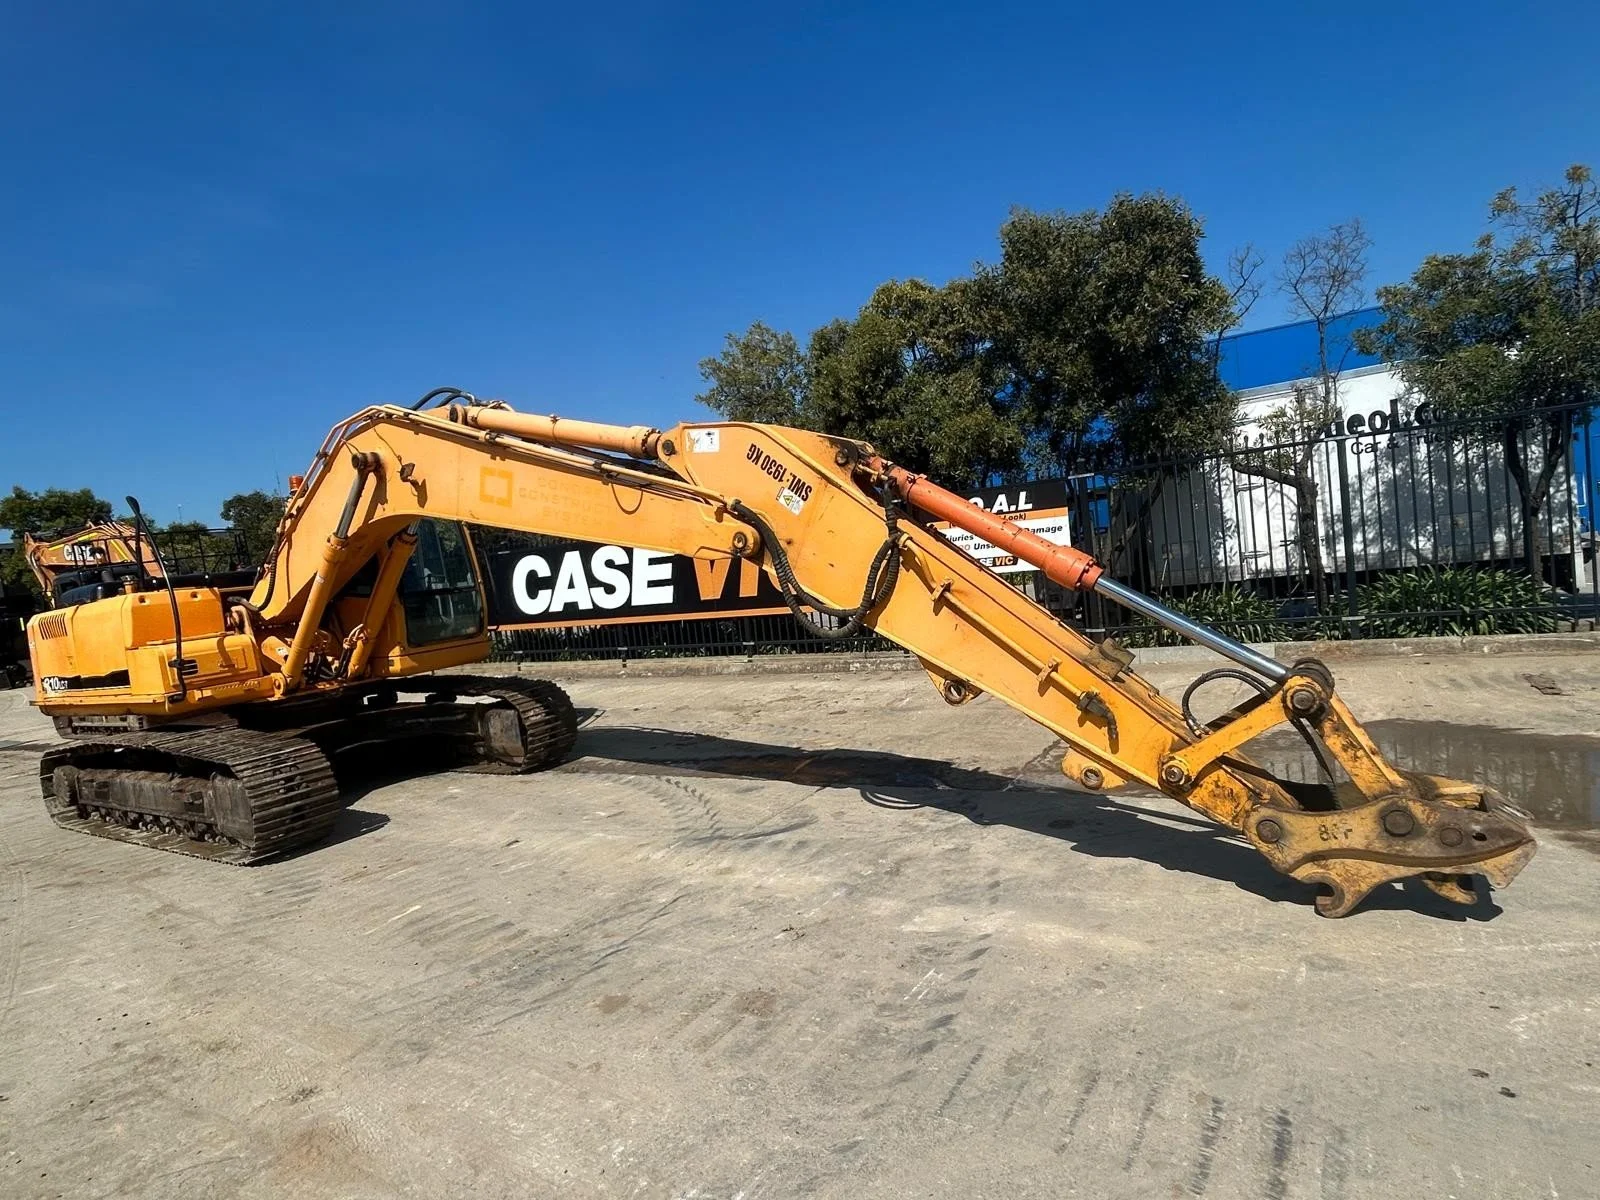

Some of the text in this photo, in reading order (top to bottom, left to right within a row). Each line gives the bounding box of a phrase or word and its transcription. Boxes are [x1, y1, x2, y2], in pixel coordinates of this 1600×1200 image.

[746, 443, 764, 466] KG
[1350, 441, 1381, 456] Car
[760, 454, 788, 483] 1930
[995, 556, 1014, 566] VIC
[512, 545, 675, 615] CASE
